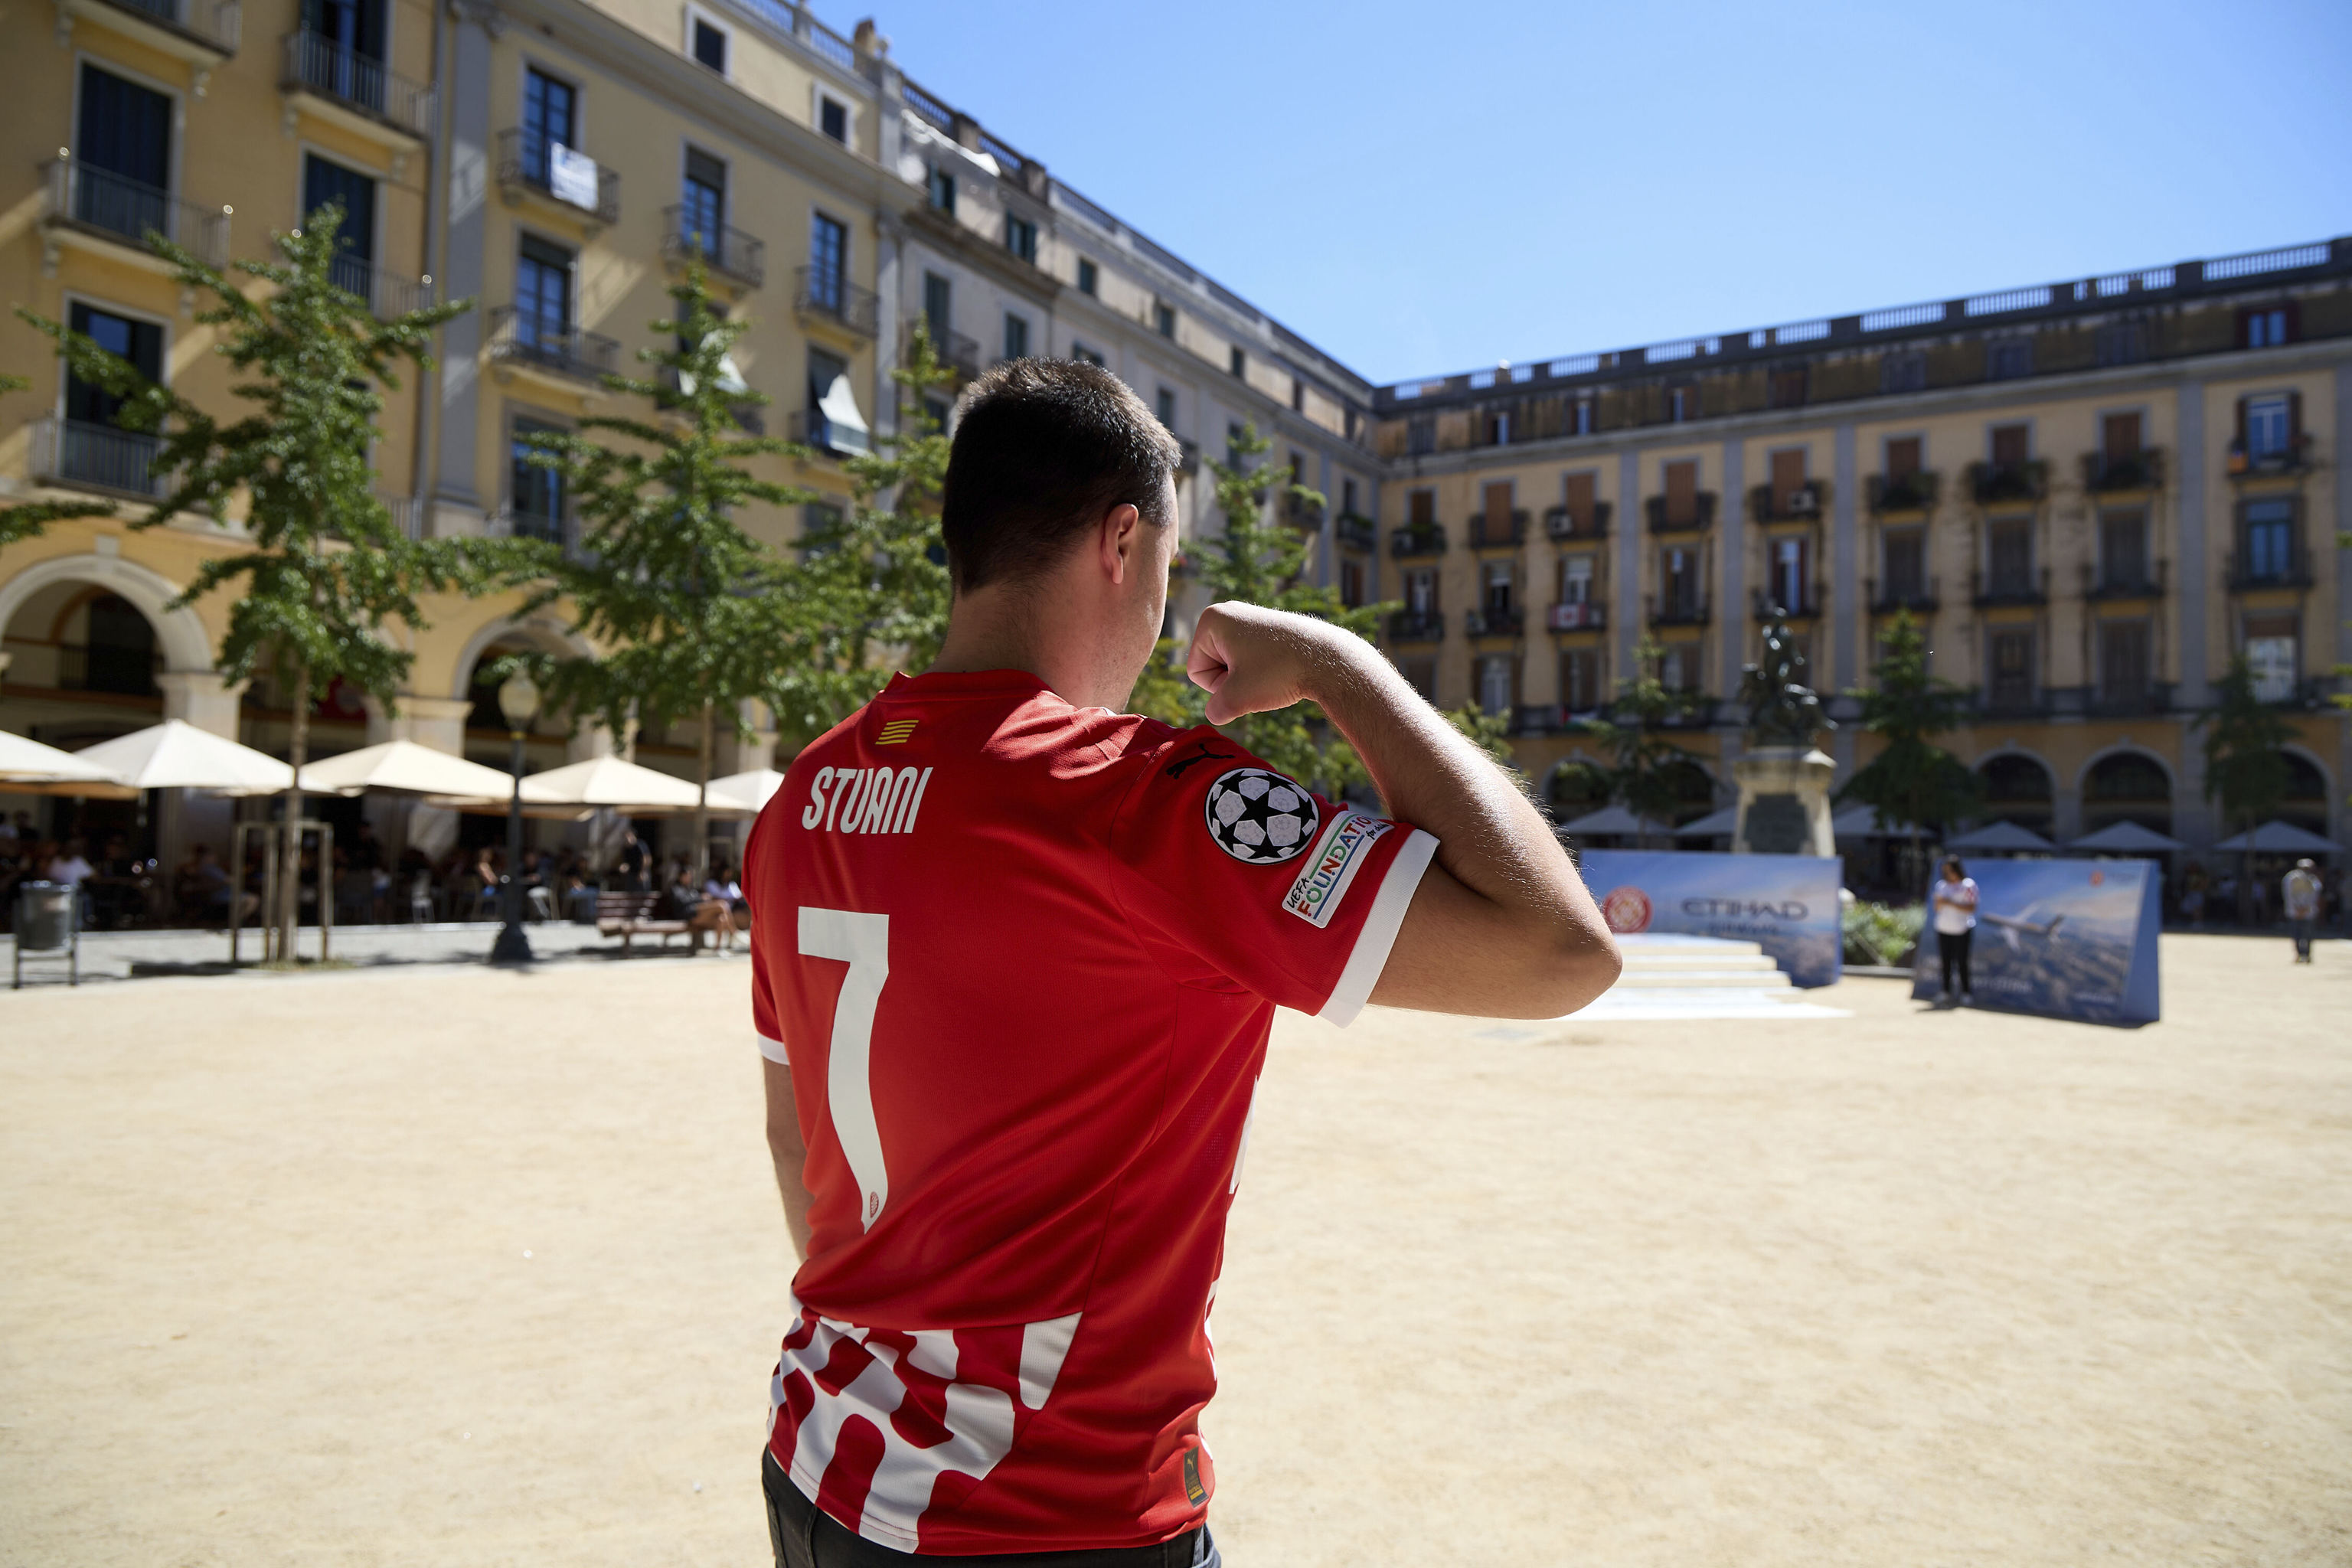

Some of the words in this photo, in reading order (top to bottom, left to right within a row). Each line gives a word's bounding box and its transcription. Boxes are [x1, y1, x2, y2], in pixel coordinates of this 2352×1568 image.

[802, 766, 934, 835] STUANI
[1286, 877, 1310, 909] UEFA
[1681, 897, 1809, 921] ETIHAD
[798, 906, 890, 1235] 7
